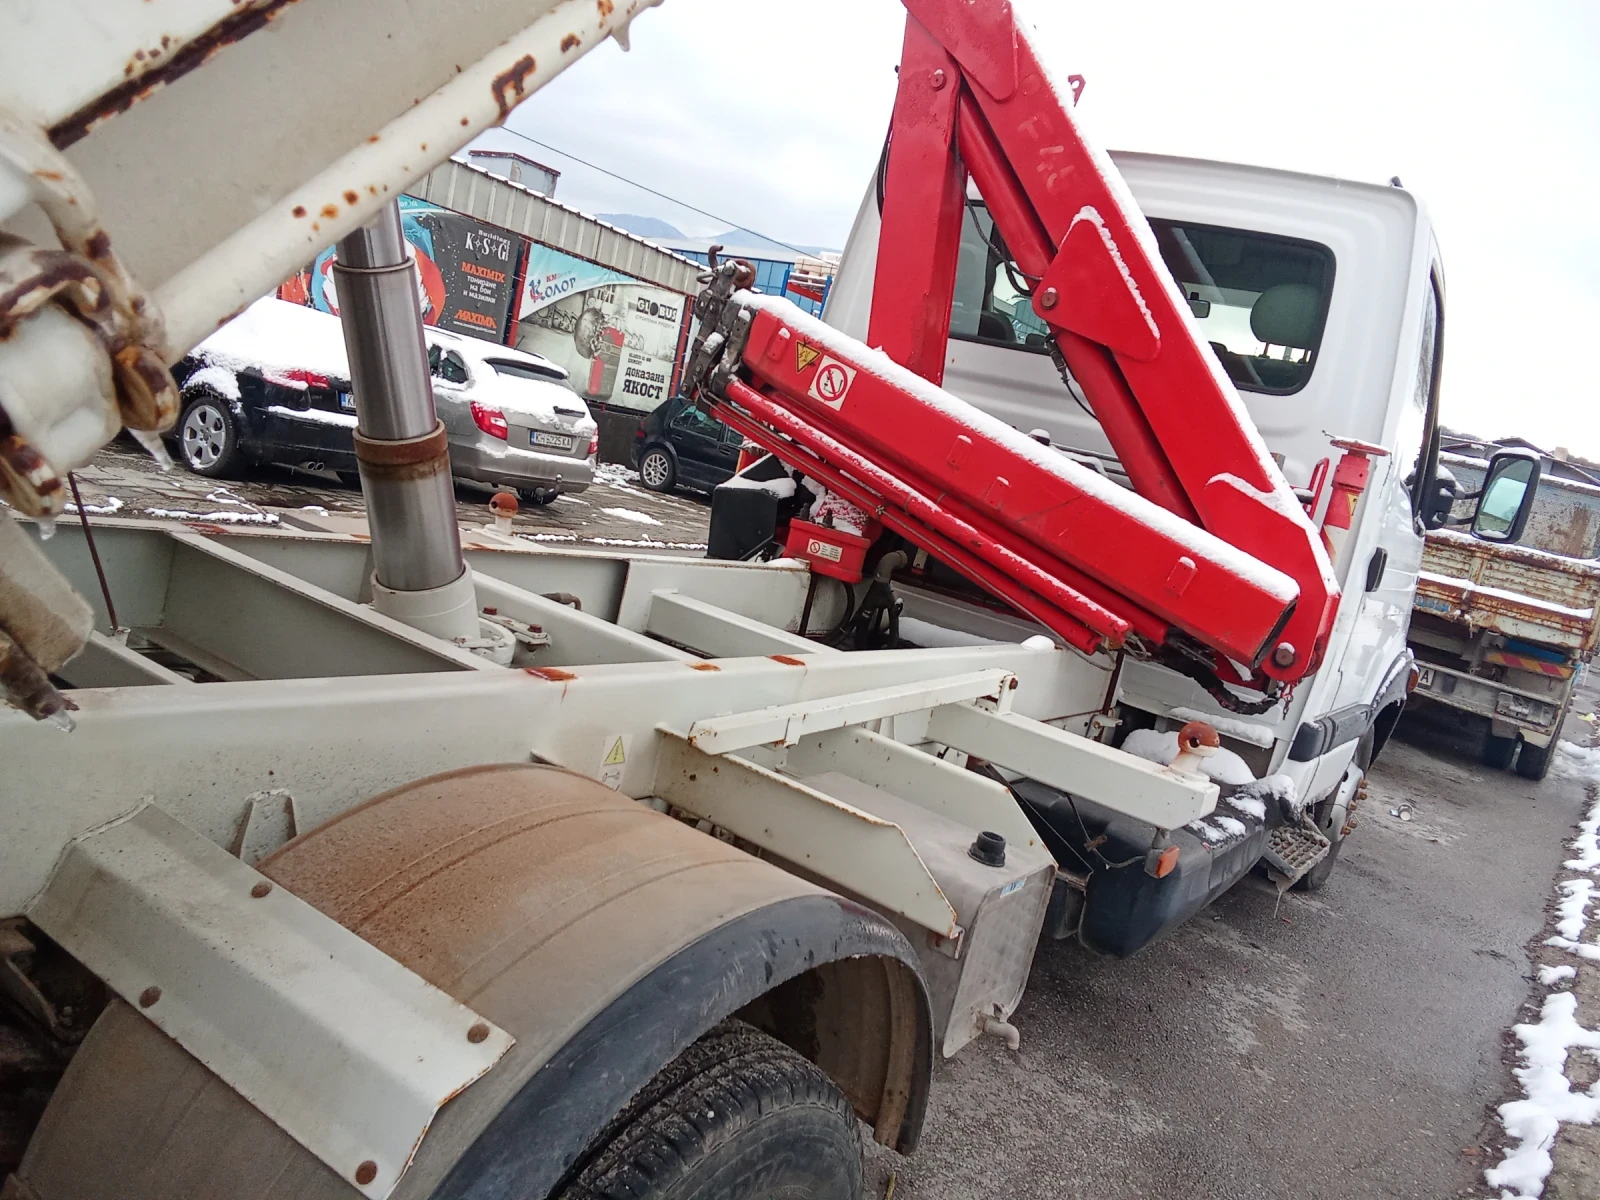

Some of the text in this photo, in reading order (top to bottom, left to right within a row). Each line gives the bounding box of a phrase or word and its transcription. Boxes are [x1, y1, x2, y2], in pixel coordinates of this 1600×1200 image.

[461, 261, 506, 283] MAXIMIX
[467, 275, 497, 290] тониране
[469, 284, 492, 295] на бои
[469, 291, 496, 304] мазилки
[454, 309, 497, 329] MAXIMA
[636, 297, 677, 322] GLOBUS
[622, 379, 663, 400] ЯКОСТ
